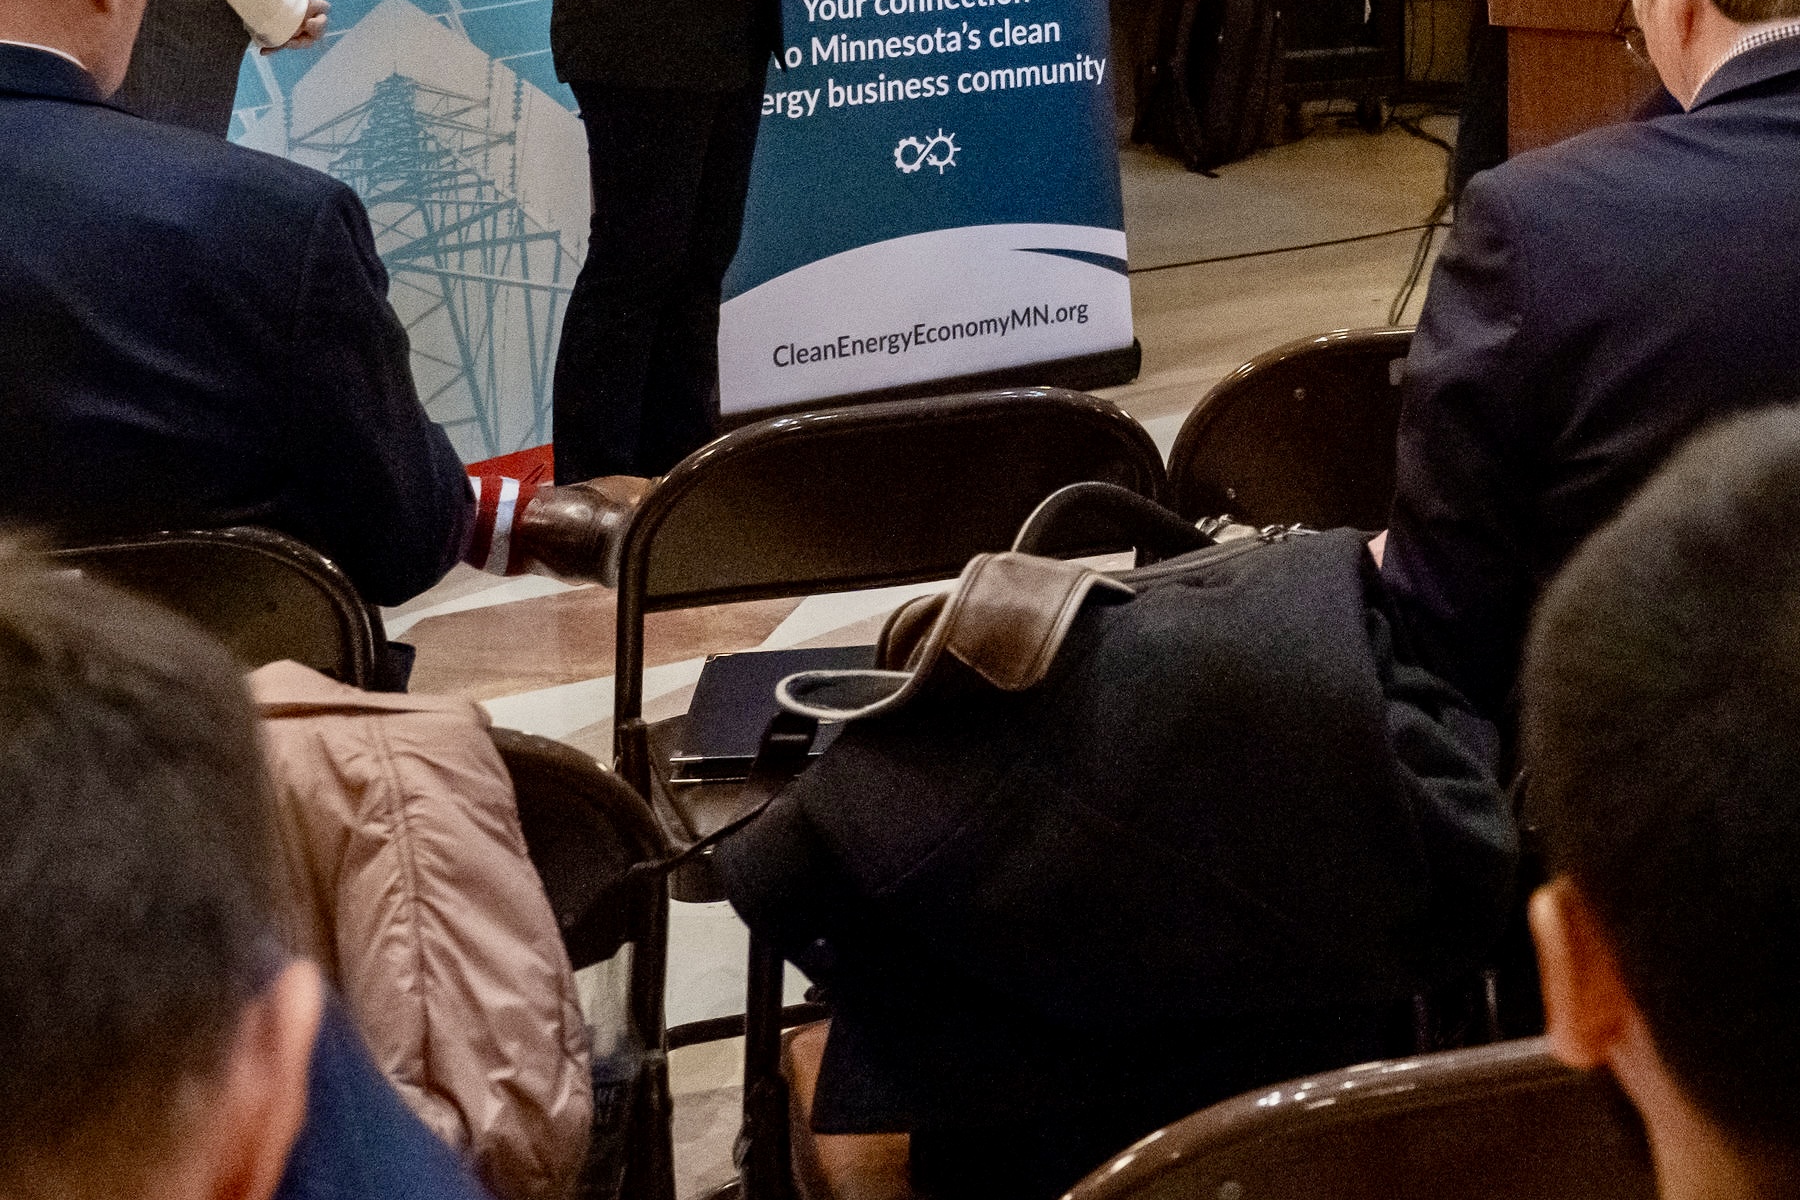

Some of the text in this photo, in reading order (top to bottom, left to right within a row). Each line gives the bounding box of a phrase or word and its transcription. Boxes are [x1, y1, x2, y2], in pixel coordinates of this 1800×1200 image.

[811, 22, 981, 67] Minnesota’s
[989, 18, 1061, 50] clean
[761, 53, 1107, 119] ergy business community
[773, 304, 1089, 368] CleanEnergyEconomyMN.org
